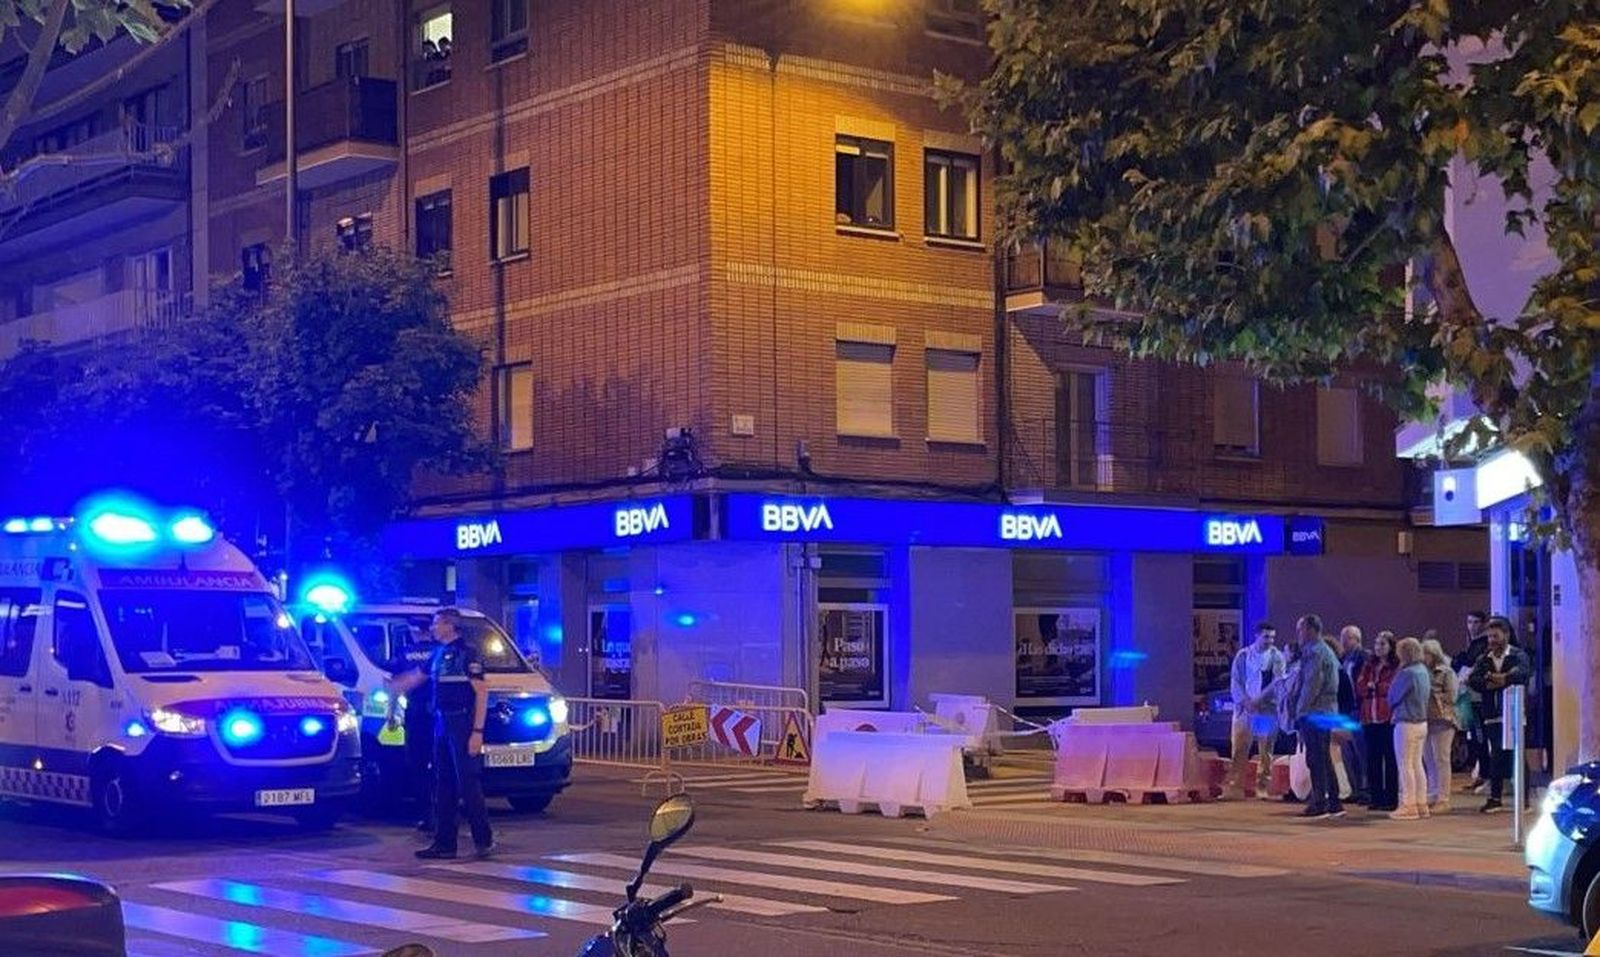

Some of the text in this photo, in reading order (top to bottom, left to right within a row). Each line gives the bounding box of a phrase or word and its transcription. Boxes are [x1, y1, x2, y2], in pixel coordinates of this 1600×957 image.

[616, 504, 668, 536] BBVA
[763, 504, 833, 532] BBVA
[1002, 513, 1062, 540] BBVA
[1208, 520, 1262, 546] BBVA
[457, 521, 502, 549] BBVA
[1292, 530, 1319, 542] BBVA
[119, 575, 254, 589] AMBULANCIA
[834, 637, 864, 653] Paso
[839, 656, 870, 672] paso
[673, 712, 695, 722] CALLE
[668, 722, 702, 735] CORTADA
[682, 732, 706, 743] OBRAS
